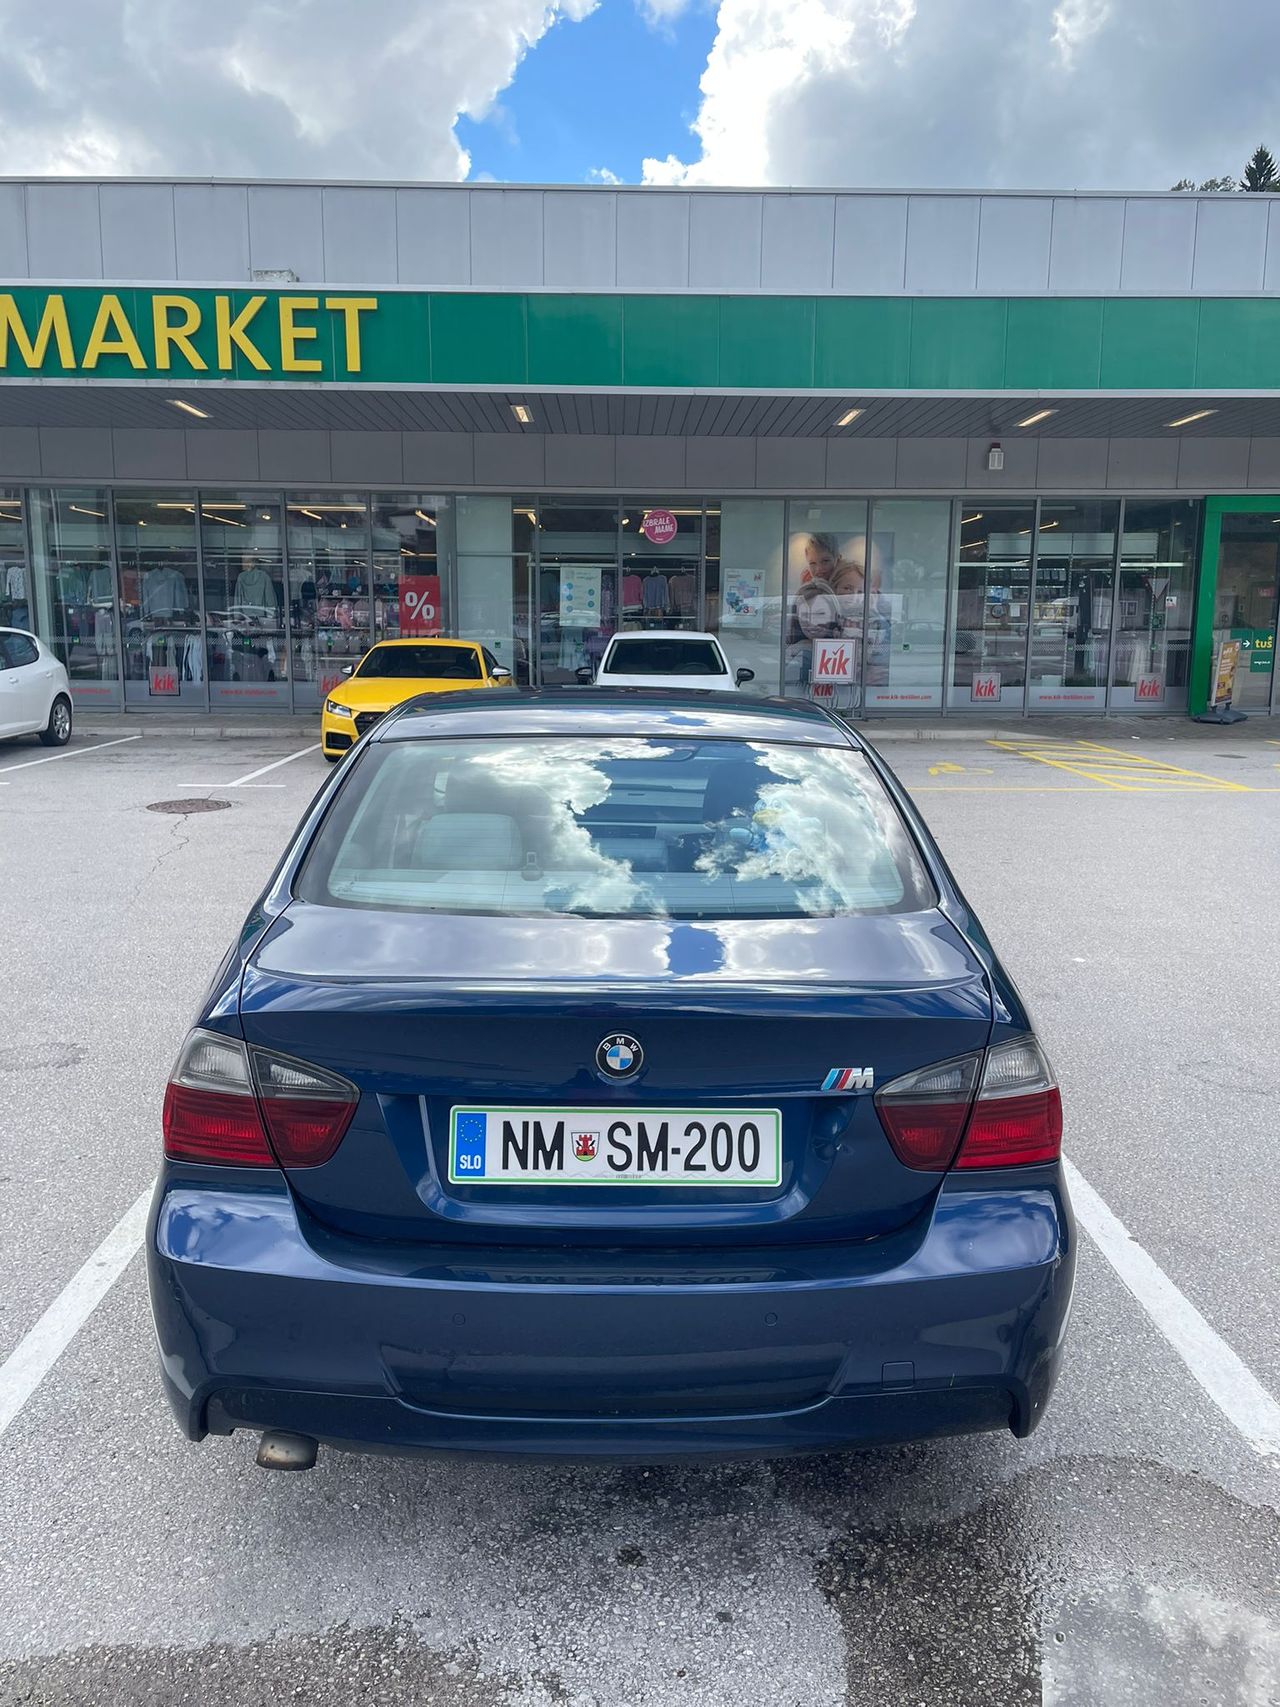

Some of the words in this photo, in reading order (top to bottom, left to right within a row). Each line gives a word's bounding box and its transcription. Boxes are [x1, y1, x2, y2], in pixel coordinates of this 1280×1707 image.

[0, 294, 378, 372] MARKET
[818, 646, 850, 675] kik
[153, 673, 177, 691] kik
[976, 679, 996, 697] kik
[1138, 679, 1161, 697] kik
[602, 1037, 639, 1052] BMW
[502, 1120, 565, 1170] NM
[607, 1121, 760, 1172] SM-200
[459, 1154, 482, 1170] SLO
